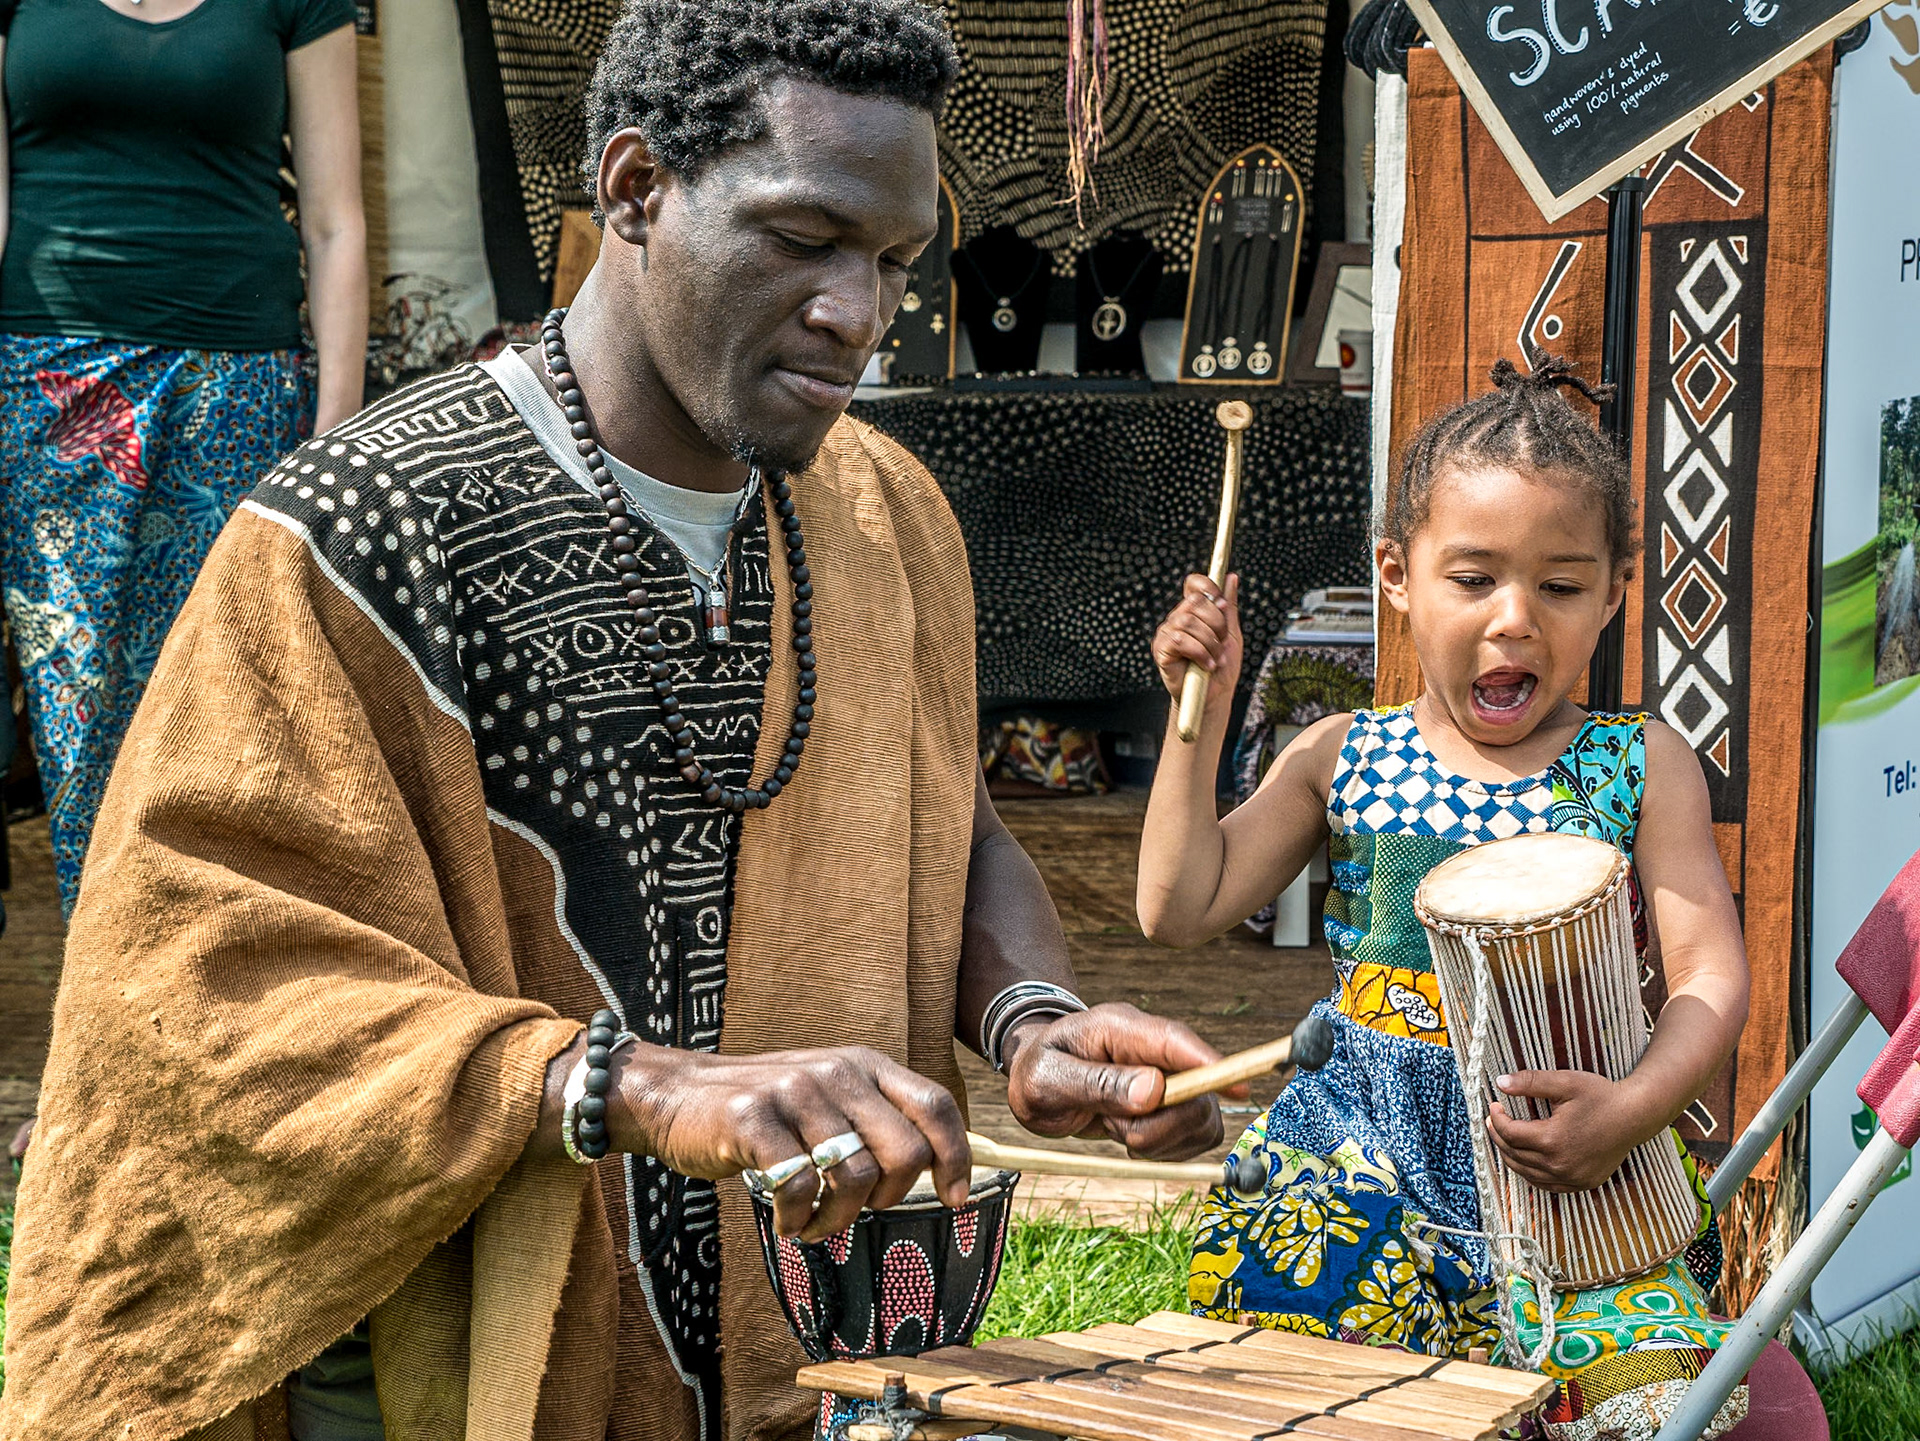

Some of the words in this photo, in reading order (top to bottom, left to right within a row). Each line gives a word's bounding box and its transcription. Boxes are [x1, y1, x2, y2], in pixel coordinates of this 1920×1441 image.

[1542, 78, 1603, 123] handwoven
[1619, 41, 1648, 70] dyed
[1551, 113, 1582, 136] using
[1585, 83, 1619, 114] 100%
[1620, 51, 1662, 90] natural
[1620, 71, 1670, 115] pigments
[1883, 760, 1917, 798] Tel:
